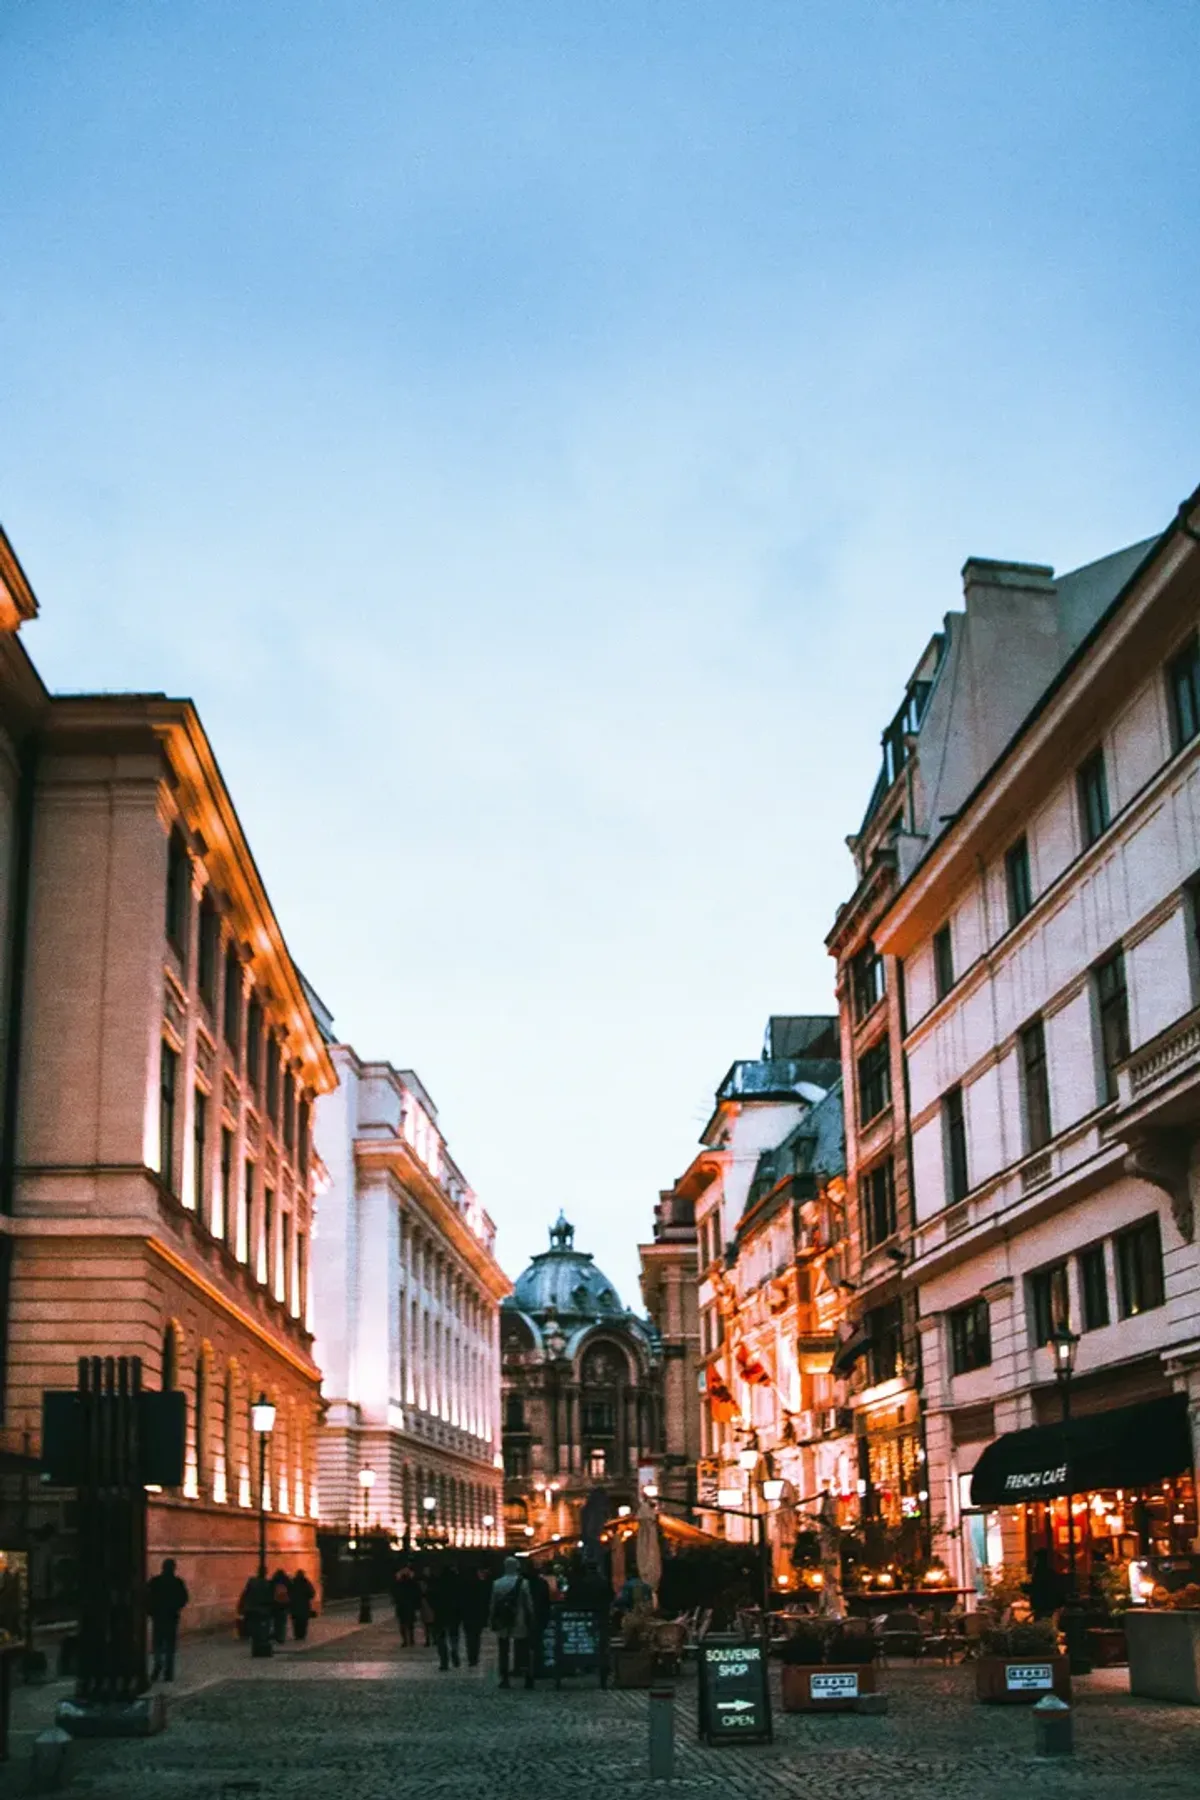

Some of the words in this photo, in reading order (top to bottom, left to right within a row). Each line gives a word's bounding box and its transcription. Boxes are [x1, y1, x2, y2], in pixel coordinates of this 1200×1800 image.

[1004, 1473, 1042, 1489] FRENCH
[1042, 1462, 1067, 1485] CAFÉ
[705, 1648, 761, 1661] SOUVENIR
[718, 1664, 748, 1676] SHOP
[721, 1715, 755, 1726] OPEN
